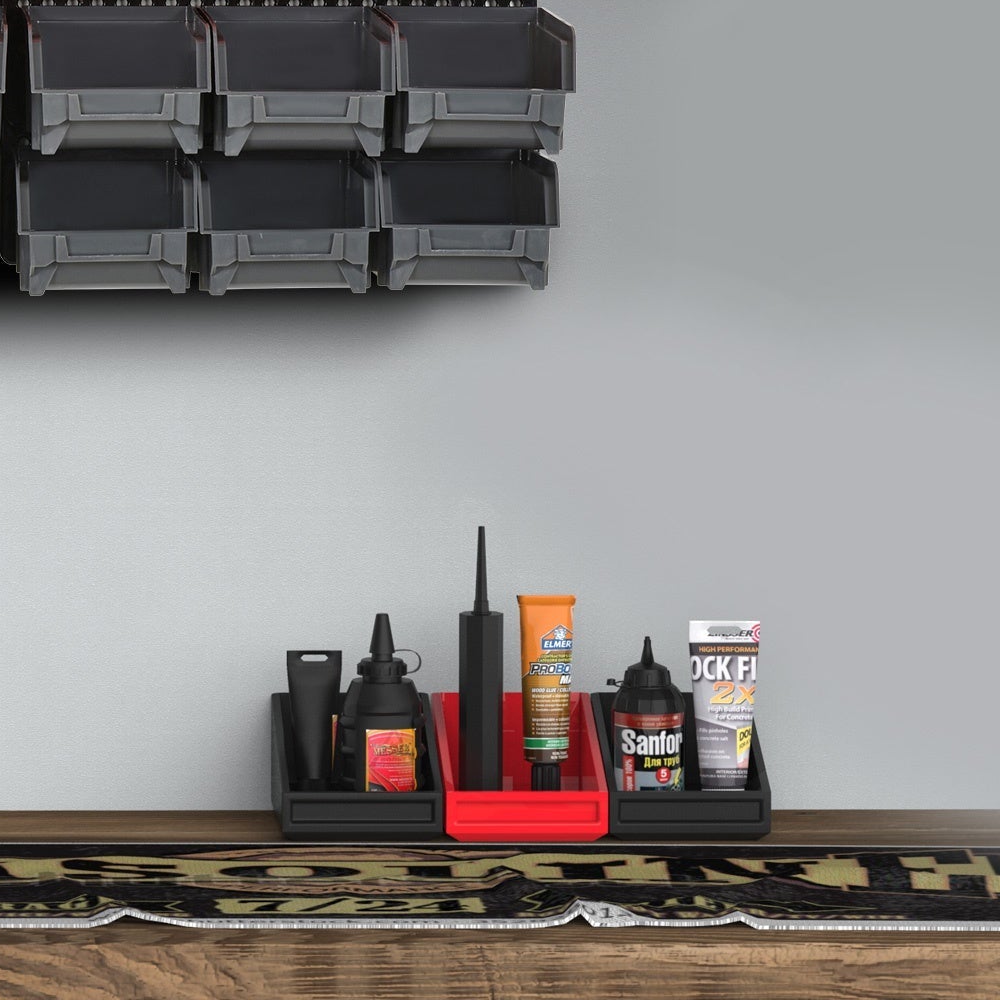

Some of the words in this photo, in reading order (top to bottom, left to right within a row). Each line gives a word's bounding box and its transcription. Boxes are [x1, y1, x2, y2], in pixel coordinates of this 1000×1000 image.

[690, 655, 732, 681] OCK
[621, 729, 683, 755] Sanfor
[644, 756, 662, 768] Для
[660, 769, 668, 778] 5
